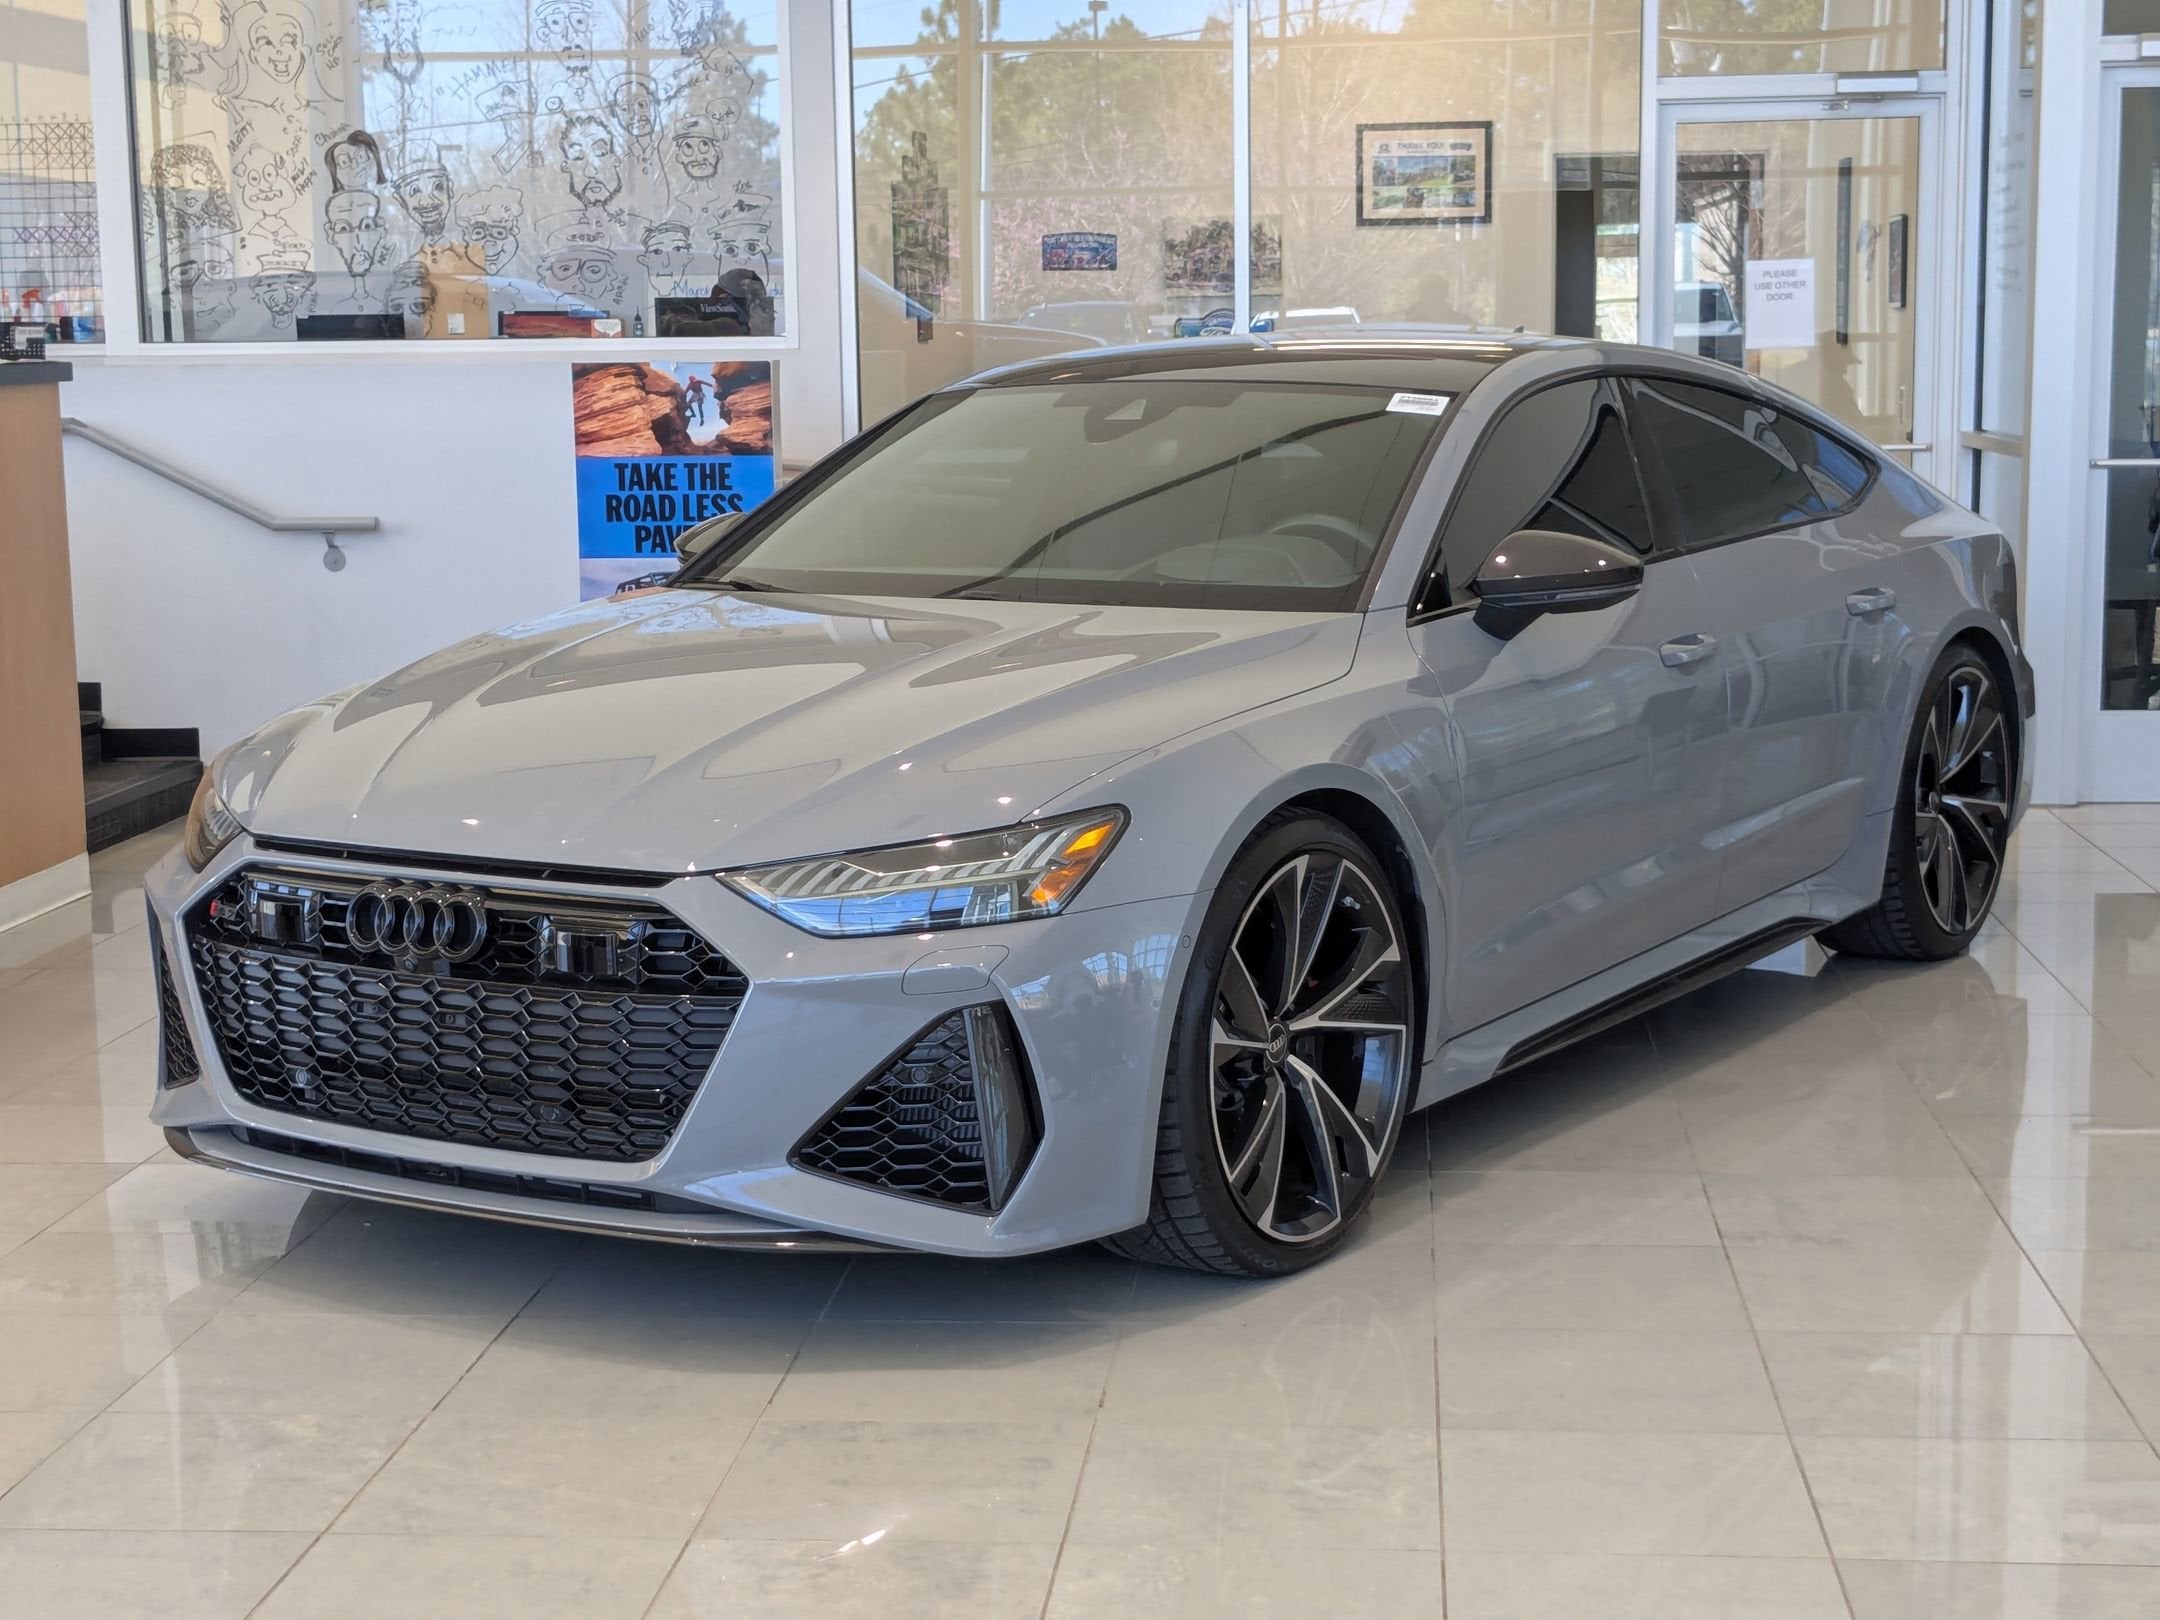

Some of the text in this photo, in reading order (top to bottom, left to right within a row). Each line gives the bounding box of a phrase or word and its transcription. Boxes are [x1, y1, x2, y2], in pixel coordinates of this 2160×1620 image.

[1762, 269, 1798, 278] PLEASE
[1754, 280, 1808, 290] USE OTHER
[1766, 292, 1794, 302] DOOR
[614, 462, 733, 492] TAKE THE
[605, 493, 744, 523] ROAD LESS
[635, 525, 694, 553] PAV
